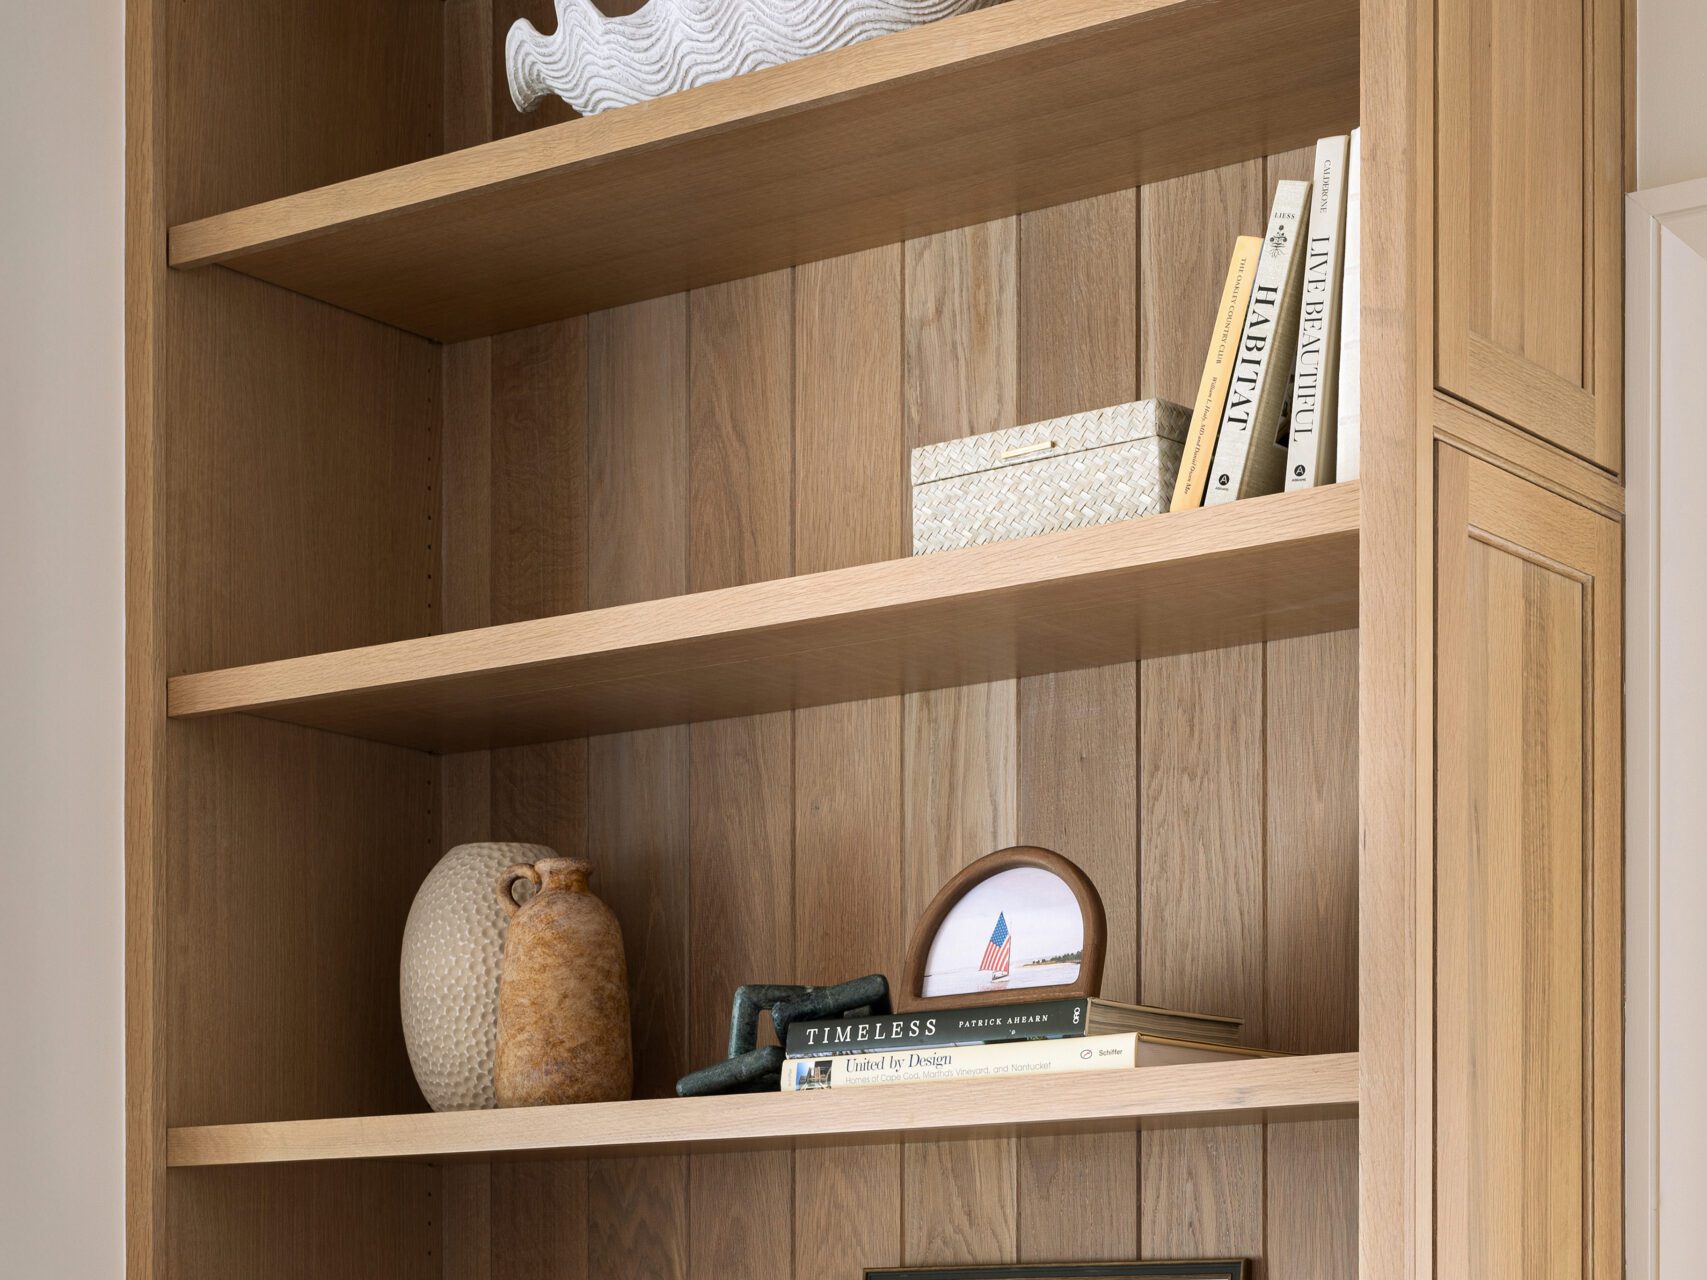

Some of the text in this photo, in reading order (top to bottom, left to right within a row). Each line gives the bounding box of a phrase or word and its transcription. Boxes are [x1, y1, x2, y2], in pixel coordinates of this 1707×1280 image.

[1319, 159, 1331, 214] CALDERONE
[1274, 211, 1296, 220] LIESS
[1215, 258, 1247, 365] THE OAKLEY COUNTRY CLUB
[1293, 236, 1330, 443] LIVE BEAUTIFUL
[1227, 284, 1279, 432] HABITAT
[806, 1014, 1049, 1045] TIMELESS PATRICK AHEARN
[846, 1051, 952, 1073] United by Design
[1098, 1048, 1123, 1057] Schiffer
[845, 1074, 870, 1084] Homes
[871, 1074, 880, 1083] of
[880, 1073, 902, 1084] Cape
[992, 1064, 1009, 1074] and
[1011, 1061, 1052, 1072] Nantucket
